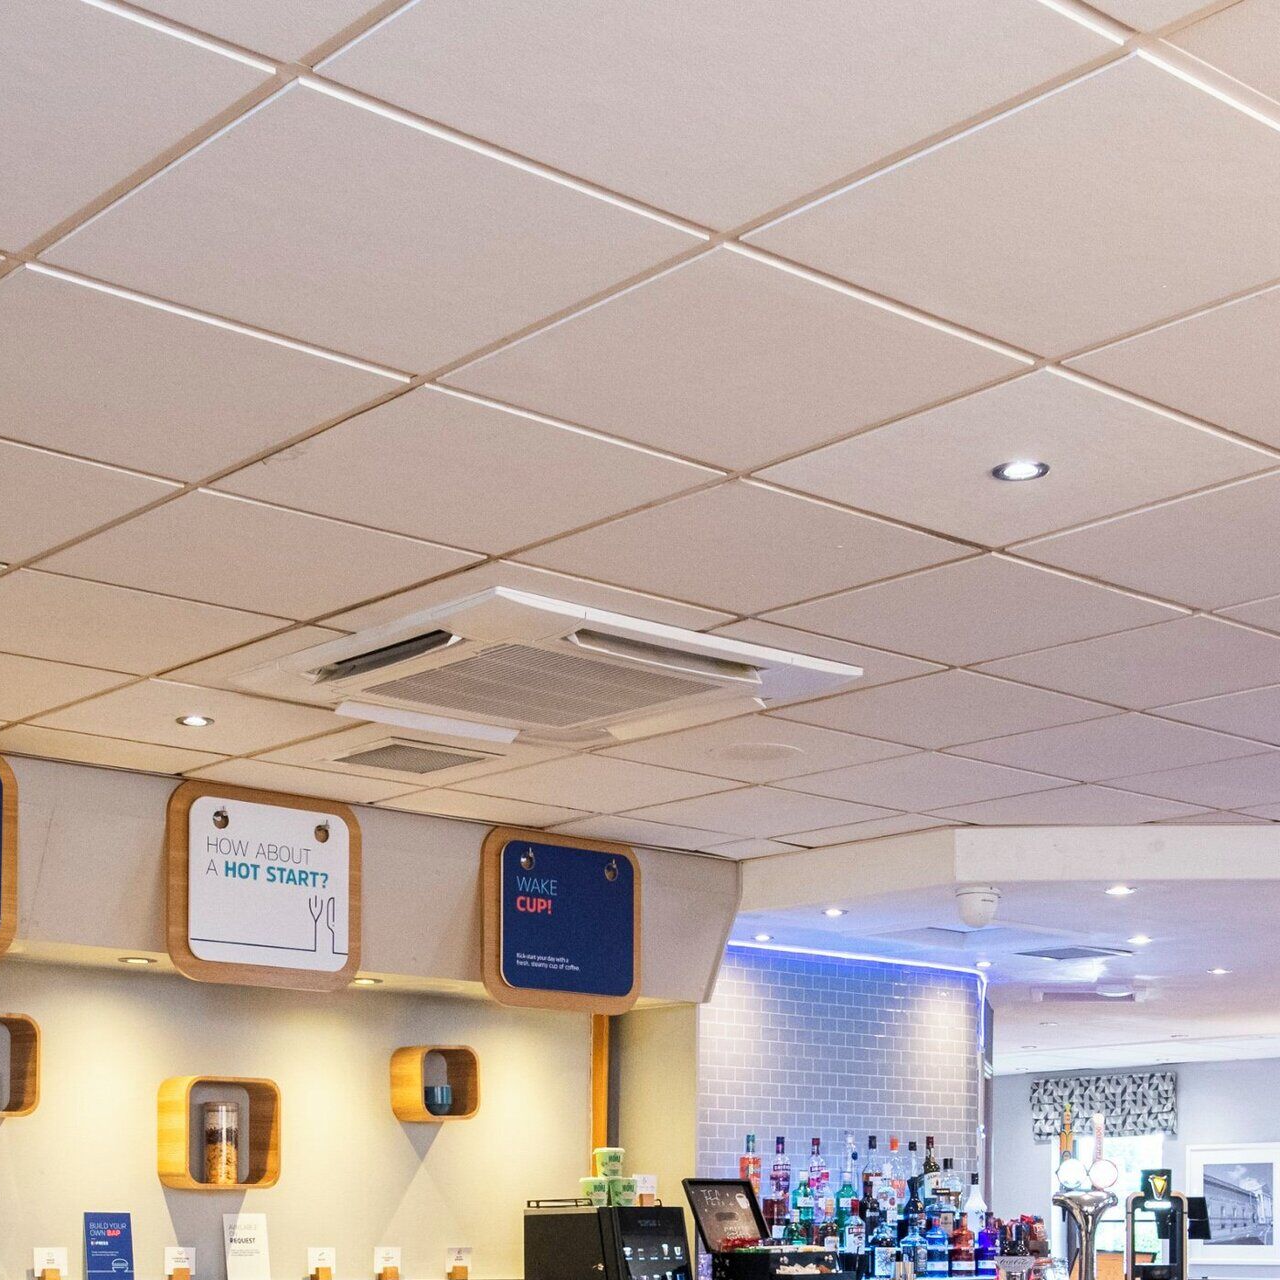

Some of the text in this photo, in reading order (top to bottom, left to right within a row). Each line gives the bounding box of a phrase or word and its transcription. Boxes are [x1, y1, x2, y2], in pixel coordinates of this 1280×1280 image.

[206, 836, 312, 865] HOW ABOUT
[205, 858, 330, 889] A HOT START?
[516, 875, 558, 896] WAKE
[515, 895, 553, 915] CUP!
[89, 1222, 127, 1230] BUILD YOUR
